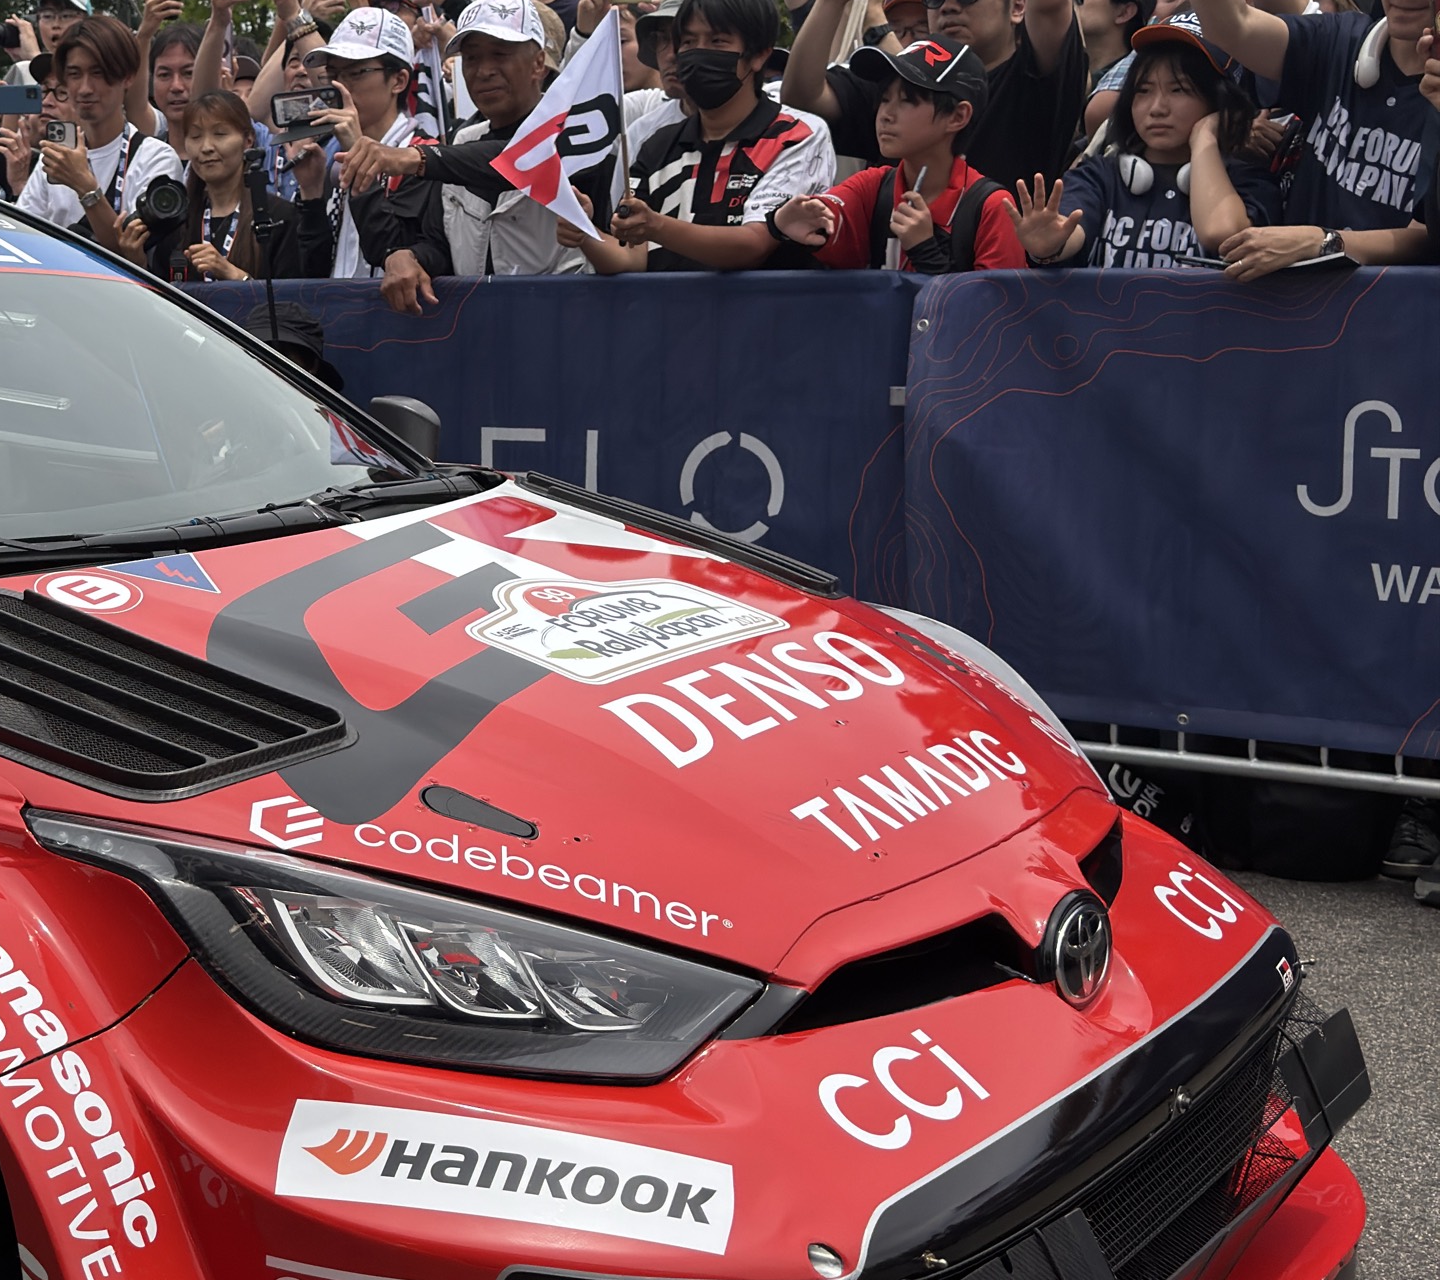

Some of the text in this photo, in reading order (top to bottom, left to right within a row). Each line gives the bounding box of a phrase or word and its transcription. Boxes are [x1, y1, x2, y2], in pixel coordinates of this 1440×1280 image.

[530, 587, 577, 604] 99
[546, 597, 662, 633] FORUM8
[728, 614, 767, 628] 2026
[599, 629, 906, 768] DENSO
[791, 729, 1028, 852] TAMADIC
[1153, 861, 1245, 941] CCi
[818, 1029, 991, 1150] CCi
